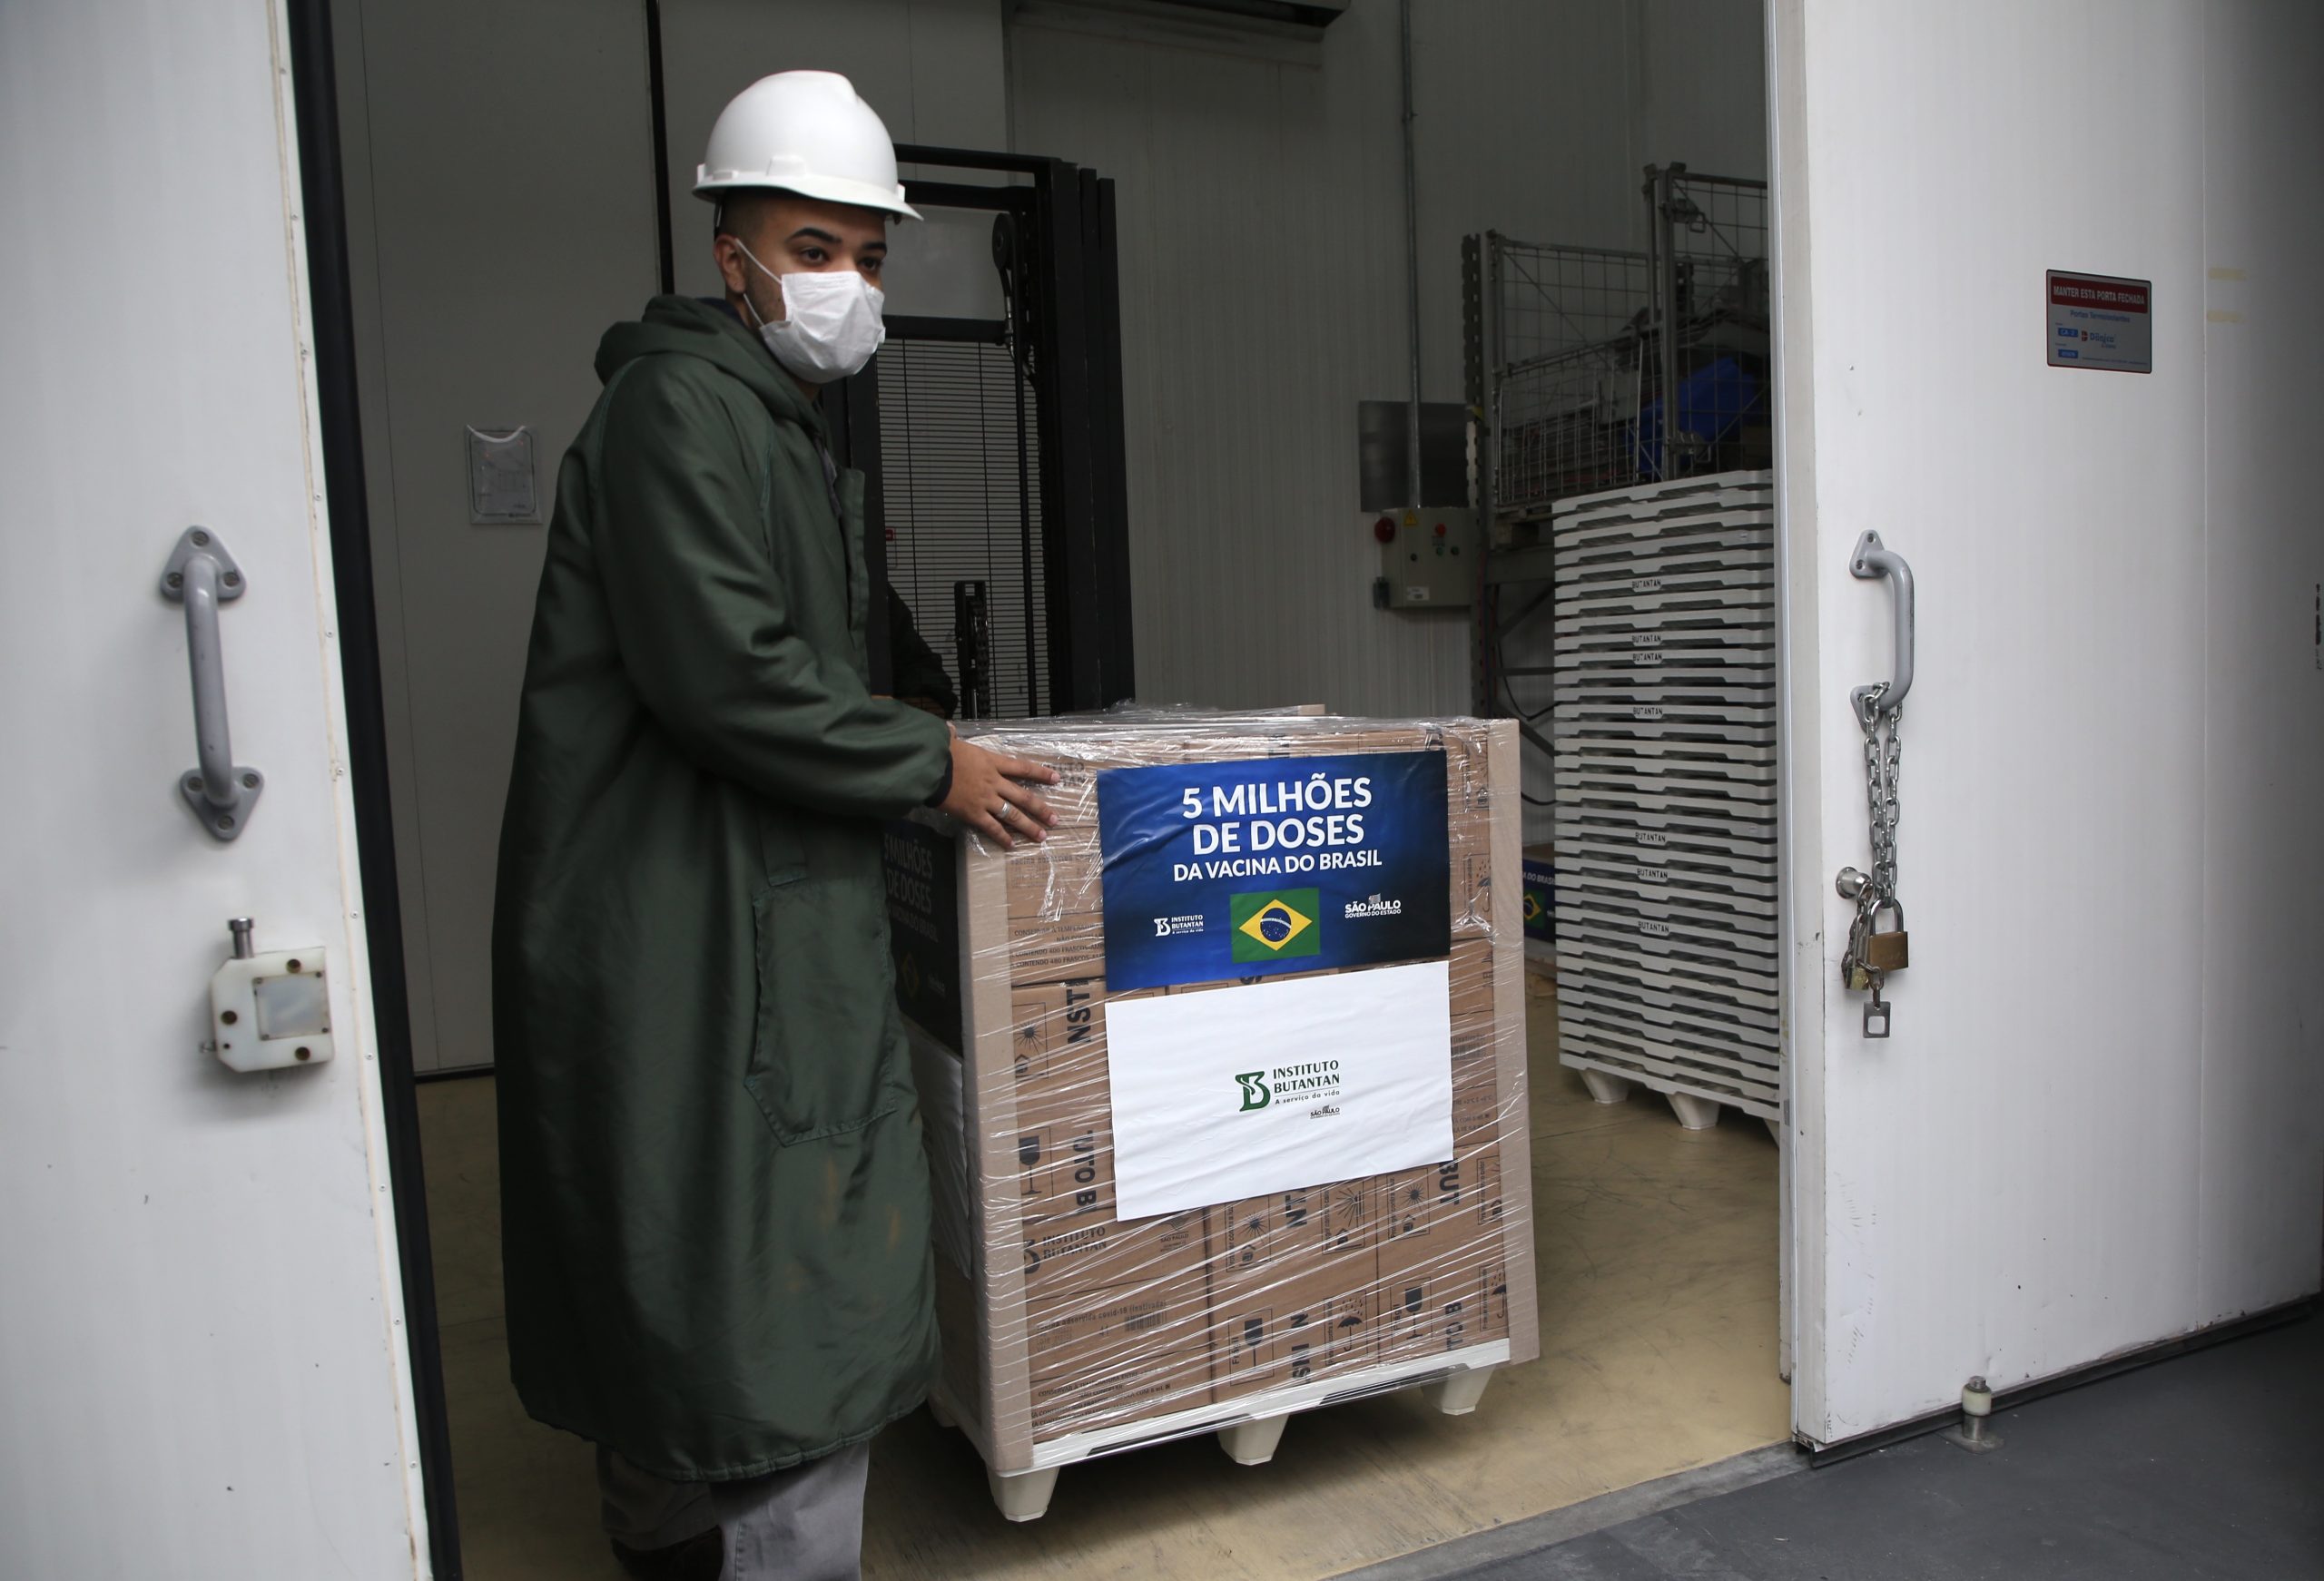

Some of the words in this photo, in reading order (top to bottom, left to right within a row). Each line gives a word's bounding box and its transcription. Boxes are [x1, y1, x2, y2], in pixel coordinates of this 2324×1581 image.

[2053, 286, 2080, 298] MANTER
[2081, 290, 2095, 300] ESTA
[2097, 290, 2117, 301] PORTA
[2118, 293, 2145, 305] FECHADA
[1632, 579, 1661, 589] BUTANTAN
[1632, 634, 1661, 643] BUTANTAN
[1632, 653, 1662, 662] BUTANTAN
[1633, 707, 1663, 716] BUTANTAN
[1182, 788, 1203, 819] 5
[1212, 772, 1373, 818] MILHÕES
[1193, 821, 1242, 856] DE
[1250, 813, 1364, 851] DOSES
[1635, 831, 1666, 842] BUTANTAN
[1173, 861, 1204, 882] DA
[1205, 856, 1282, 879] VACINA
[1285, 853, 1315, 873] DO
[1319, 849, 1383, 870] BRASIL
[1637, 868, 1668, 879] BUTANTAN
[900, 877, 932, 915] DOSES
[1344, 901, 1367, 914] SÃO
[1367, 899, 1402, 911] PAULO
[1171, 914, 1204, 923] INSTITUTO
[1171, 920, 1204, 929] BUTANTAN
[1638, 921, 1669, 933] BUTANTAN
[1273, 1060, 1339, 1079] INSTITUTO
[1274, 1073, 1340, 1094] BUTANTAN
[1283, 1094, 1309, 1104] serviço
[1310, 1109, 1322, 1117] SÃO
[1439, 1158, 1460, 1205] BUT
[1042, 1226, 1106, 1247] INSTITUTO
[1043, 1241, 1108, 1260] BUTANTAN
[1098, 1307, 1128, 1319] covid-19
